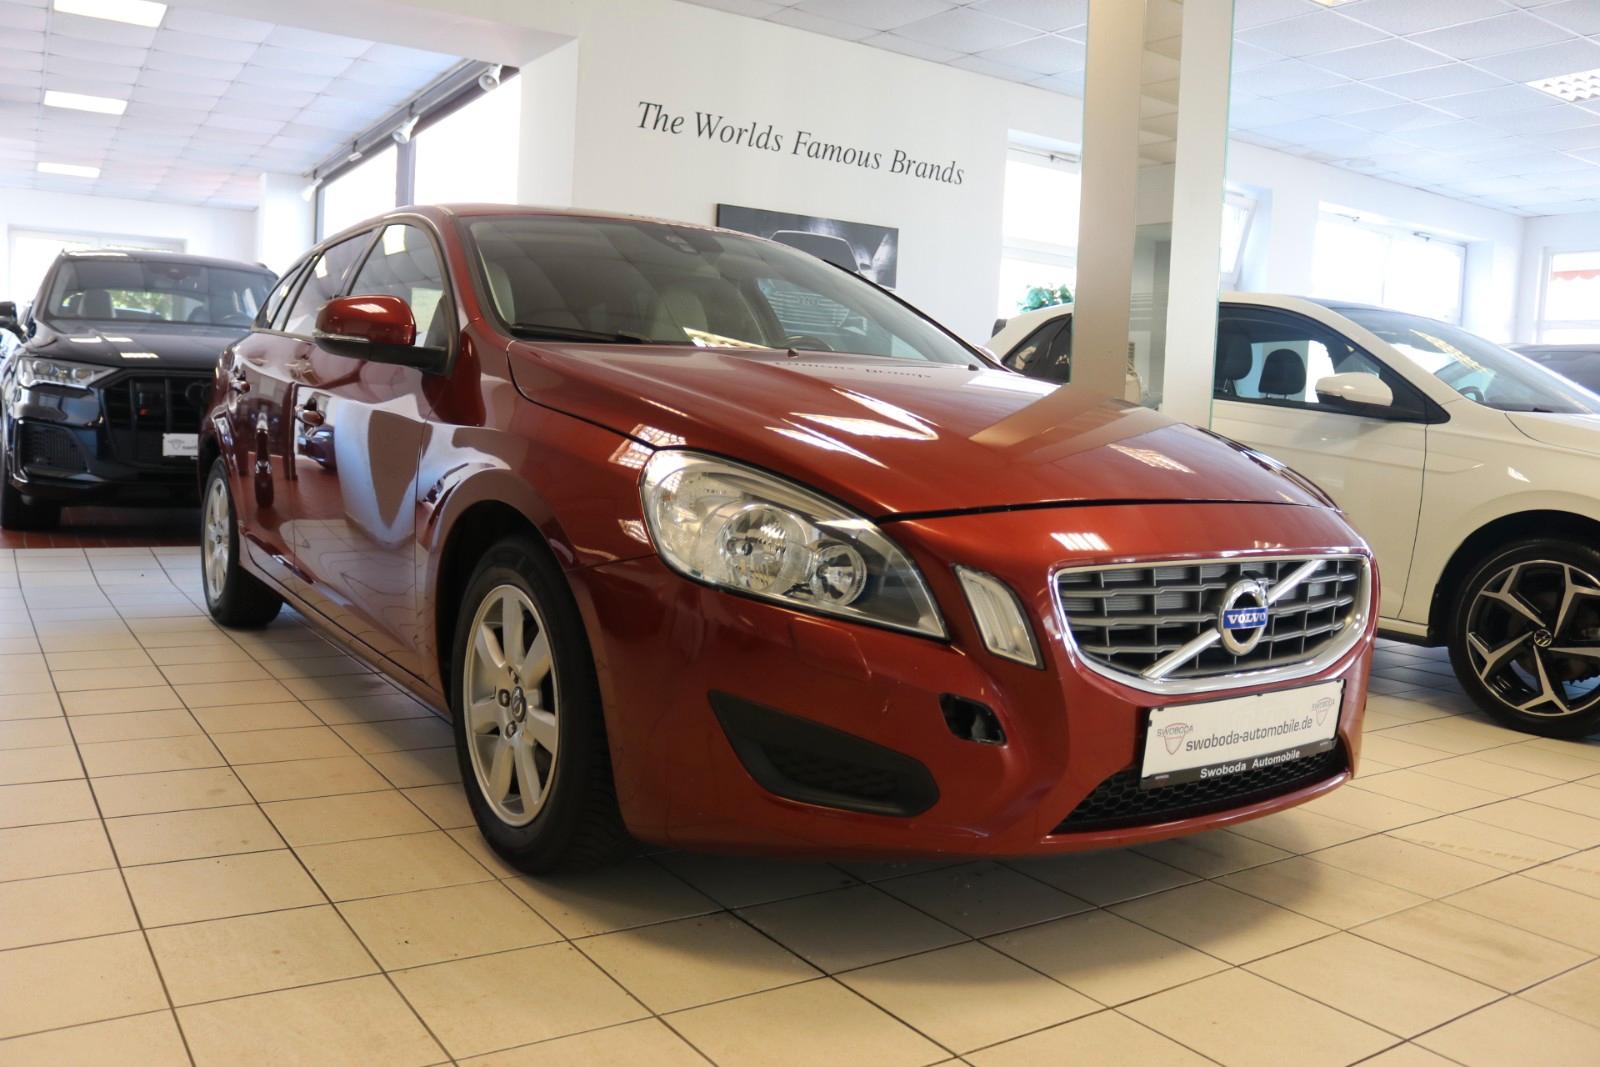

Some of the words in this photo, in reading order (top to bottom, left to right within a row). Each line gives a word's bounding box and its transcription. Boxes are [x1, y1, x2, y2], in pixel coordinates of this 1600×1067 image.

[637, 101, 685, 135] The
[695, 111, 784, 152] Worlds
[791, 130, 882, 170] Famous
[889, 149, 965, 186] Brands
[1227, 612, 1266, 625] VOLVO
[1156, 724, 1194, 737] SWOBODA
[1185, 715, 1313, 752] swoboda-automobile.de
[1200, 761, 1247, 779] Swoboda
[1251, 750, 1300, 769] Automobile
